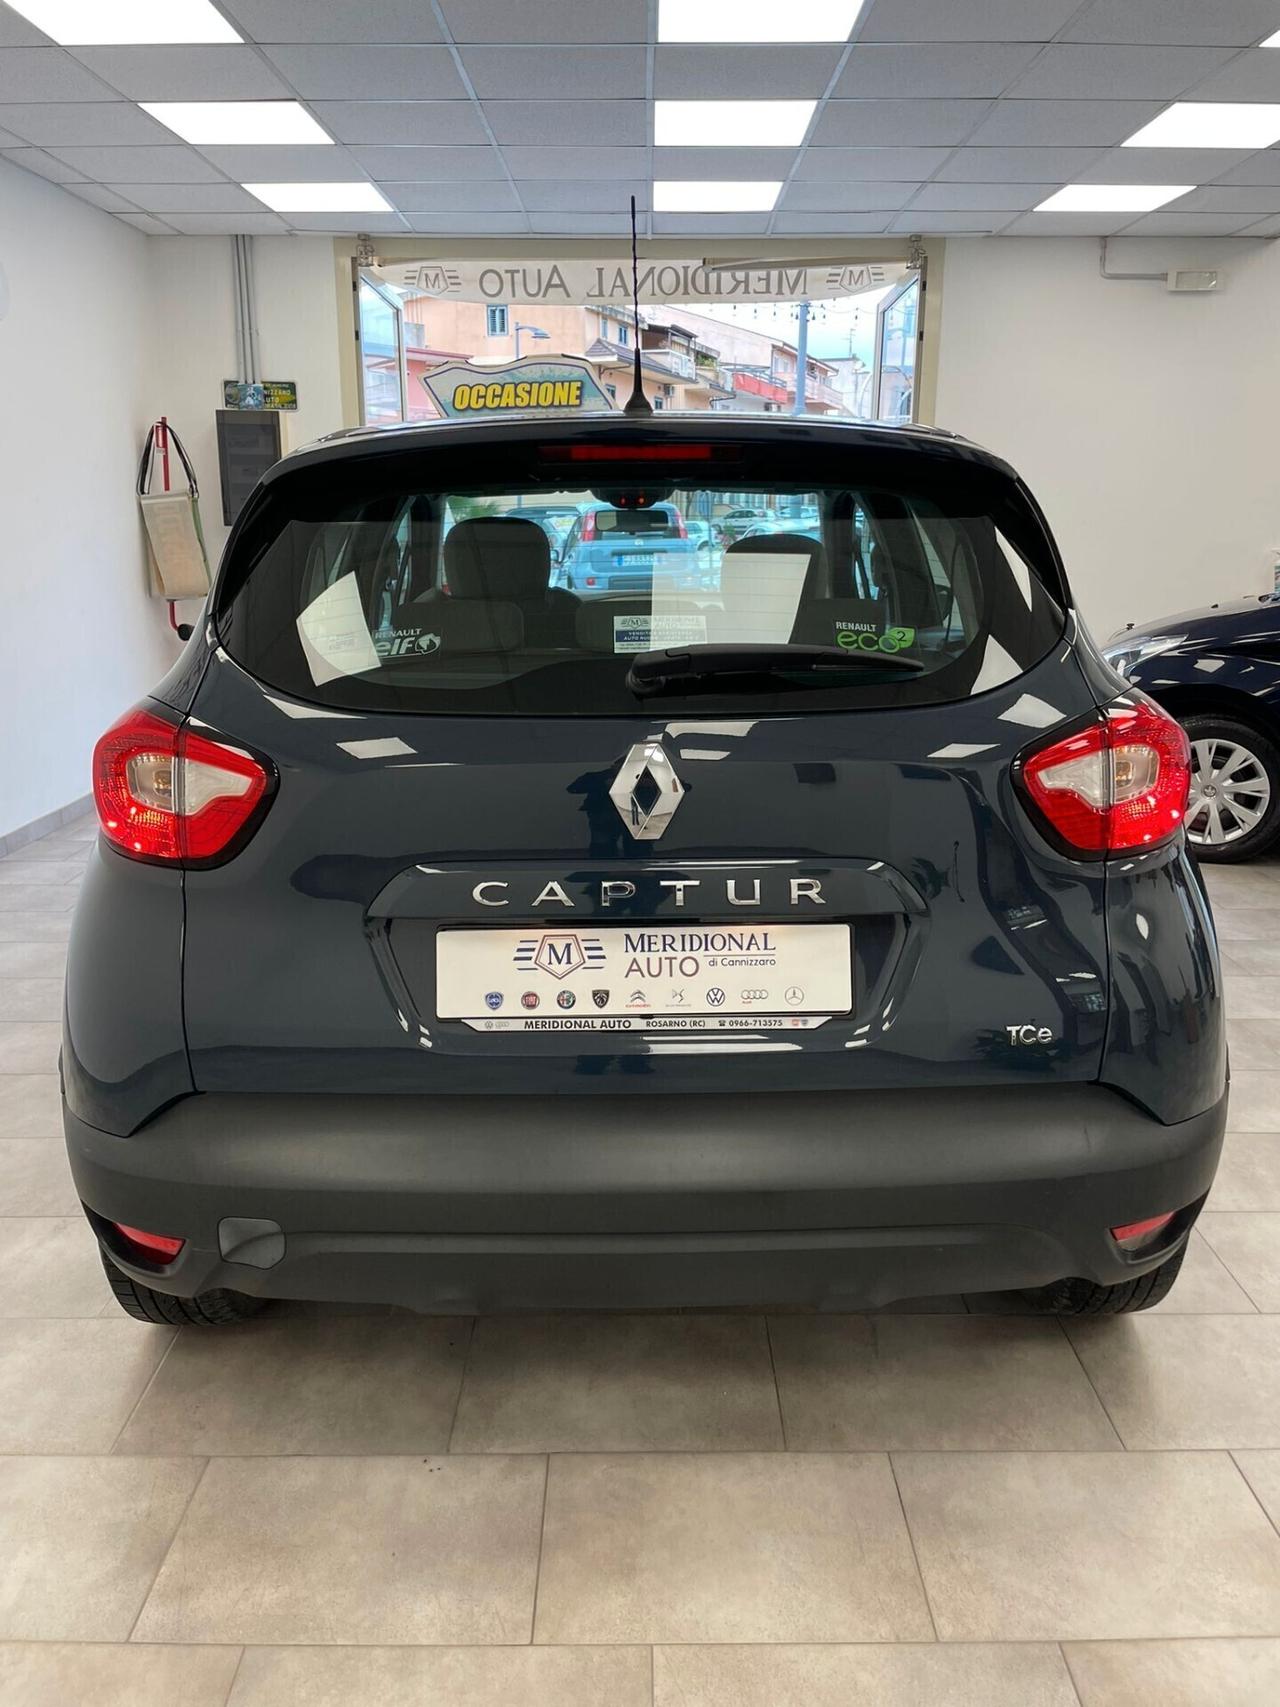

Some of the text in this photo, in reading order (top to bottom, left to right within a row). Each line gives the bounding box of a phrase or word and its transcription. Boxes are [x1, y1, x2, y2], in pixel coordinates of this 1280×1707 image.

[453, 381, 582, 410] OCCASIONE
[375, 628, 422, 639] RENAULT
[836, 621, 877, 632] RENAULT
[472, 879, 826, 907] CAPTUR
[624, 933, 776, 953] MERIDIONAL
[547, 943, 573, 965] M
[708, 956, 776, 968] di Cannizzaro
[624, 956, 700, 978] AUTO
[523, 1018, 783, 1030] MERIDIONAL AUTO ROSARNO (RC) 0966-713575
[1006, 1025, 1053, 1046] TCe
